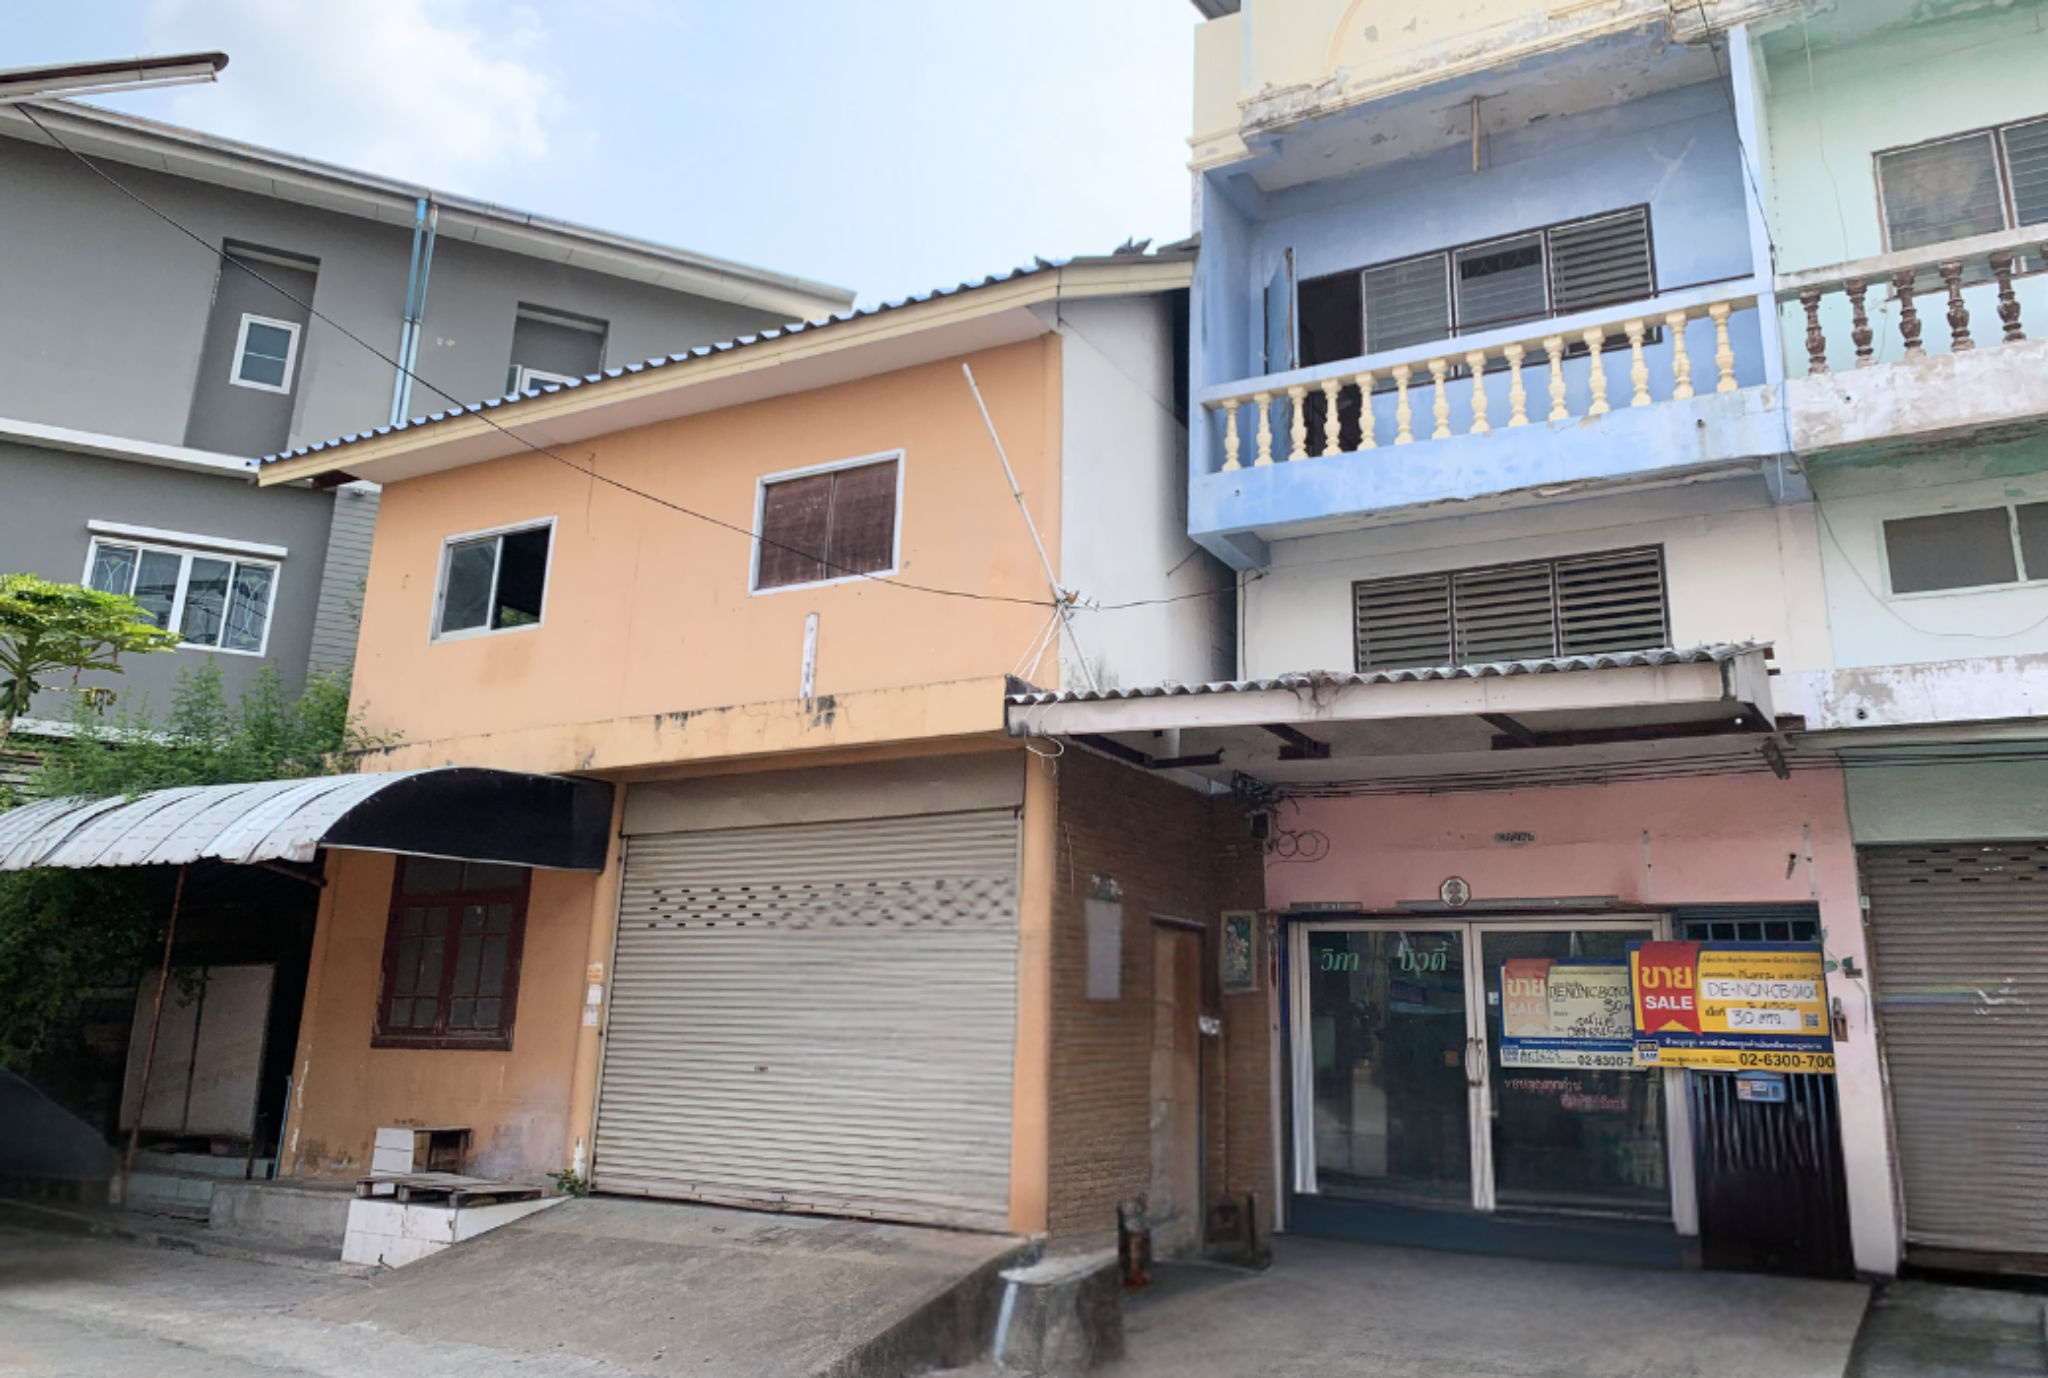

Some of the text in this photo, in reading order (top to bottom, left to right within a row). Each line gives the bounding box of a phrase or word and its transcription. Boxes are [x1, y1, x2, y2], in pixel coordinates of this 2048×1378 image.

[1641, 966, 1693, 989] ขาย
[1508, 978, 1545, 998] ขาย
[1509, 1001, 1545, 1014] SALE
[1645, 995, 1694, 1010] SALE
[1731, 1009, 1755, 1025] 30
[1577, 1055, 1634, 1067] 02-6300-7
[1739, 1053, 1835, 1068] 02-6300-700
